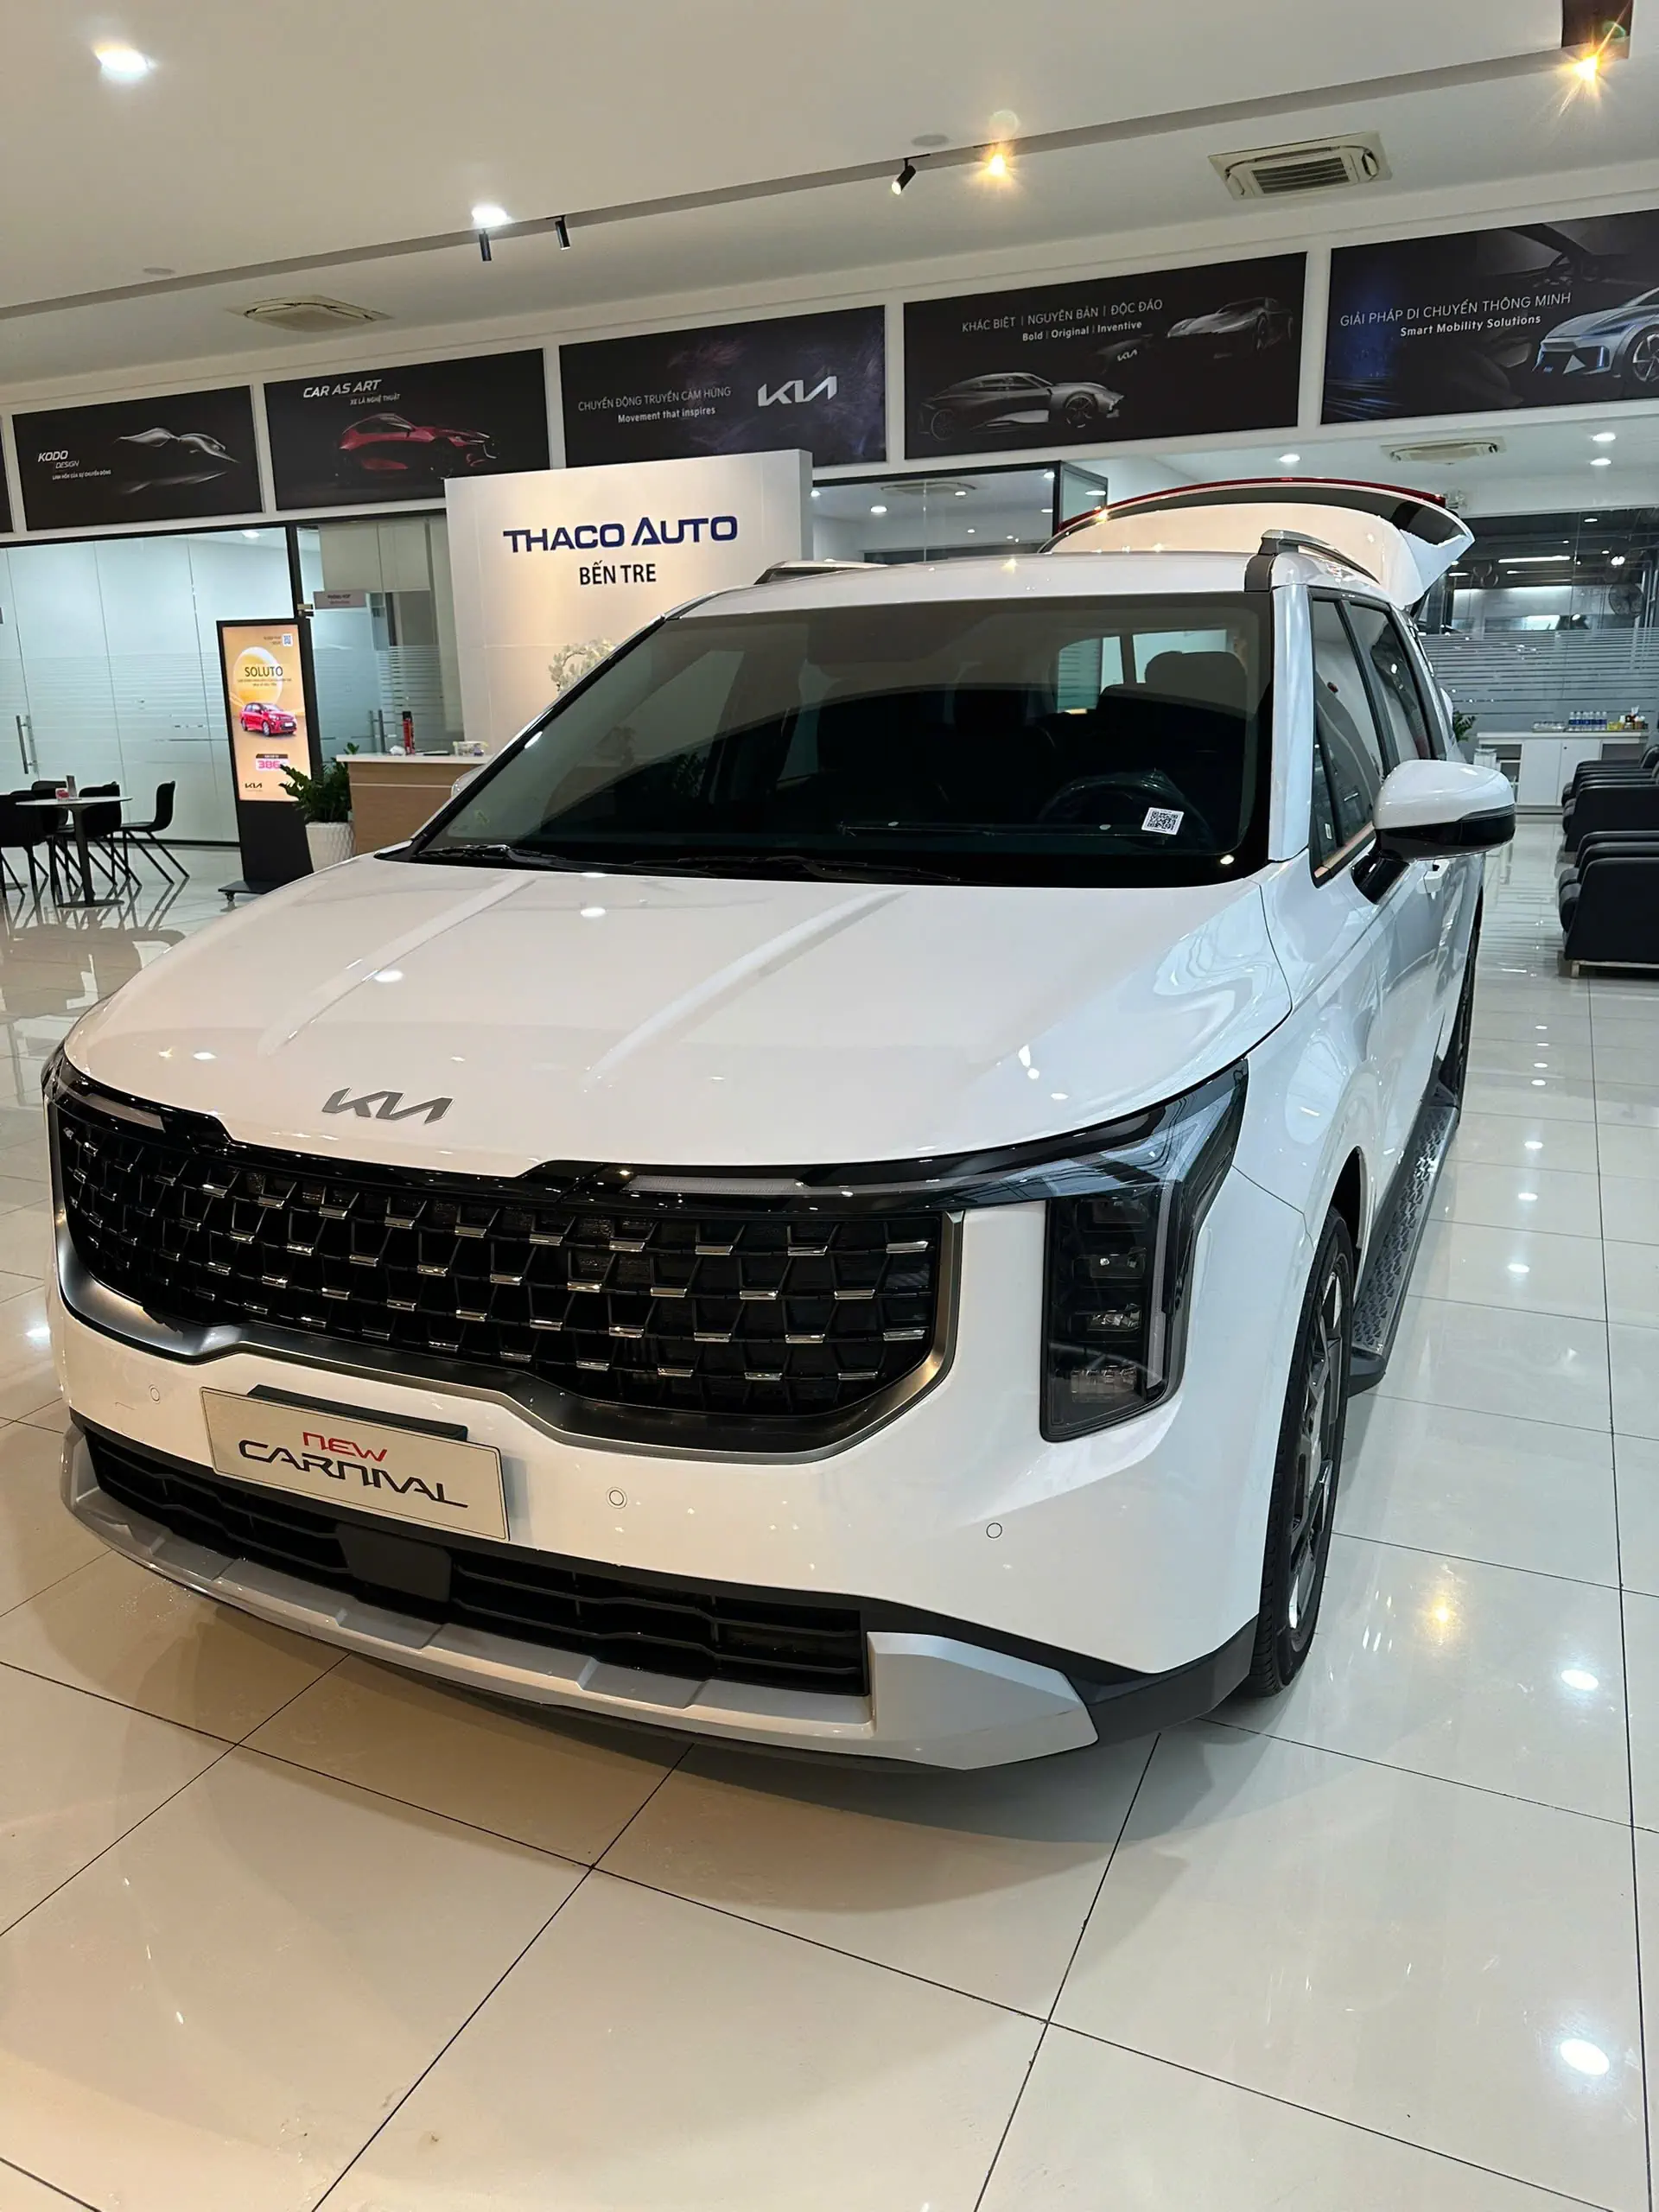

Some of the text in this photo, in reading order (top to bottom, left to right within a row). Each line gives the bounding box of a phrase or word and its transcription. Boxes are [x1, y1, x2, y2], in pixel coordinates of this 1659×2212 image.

[962, 297, 1163, 333] KHÁC BIỆT NGUYÊN BẢN ĐỘC ĐÁO
[1340, 292, 1572, 327] GIẢI PHÁP DI CHUYỂN THÔNG MINH
[1022, 321, 1142, 341] Bold Original Inventive
[1400, 315, 1541, 338] Smart Mobility Solutions
[1116, 348, 1138, 362] KIA
[302, 378, 382, 398] CAR AS ART
[757, 375, 838, 407] KIA
[615, 396, 642, 409] ĐỘNG
[618, 405, 716, 423] Movement that inspires
[37, 450, 68, 462] KODO
[55, 460, 79, 469] DESIGN
[503, 516, 738, 553] THACO AUTO
[579, 559, 657, 585] BẾN TRE
[245, 666, 283, 677] SOLUTO
[321, 1086, 455, 1124] KIA
[302, 1431, 388, 1462] NEW
[238, 1439, 468, 1509] CARNIVAL
